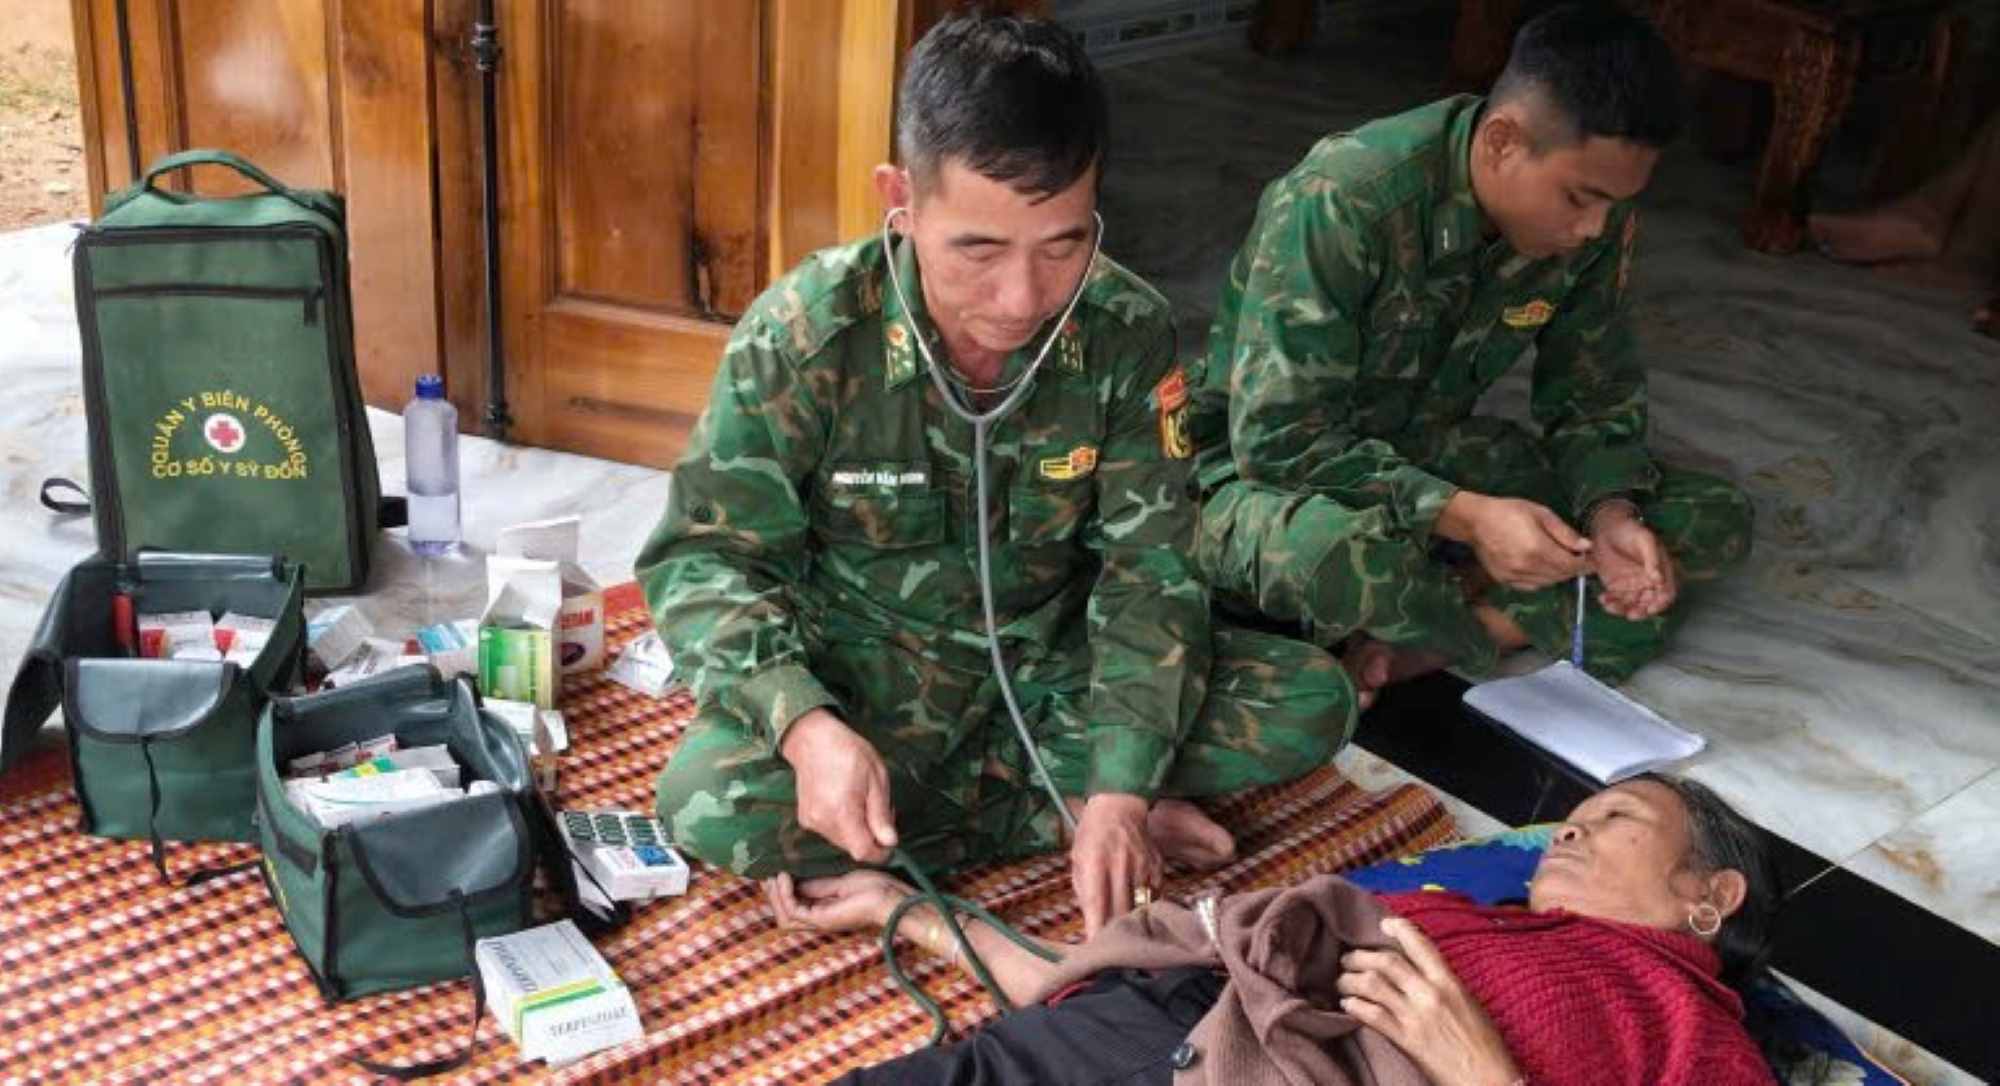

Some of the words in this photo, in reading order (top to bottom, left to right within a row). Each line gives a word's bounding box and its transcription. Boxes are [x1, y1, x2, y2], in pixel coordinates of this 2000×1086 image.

[180, 396, 196, 412] Y
[201, 389, 250, 411] BIÊN
[218, 461, 232, 475] Y
